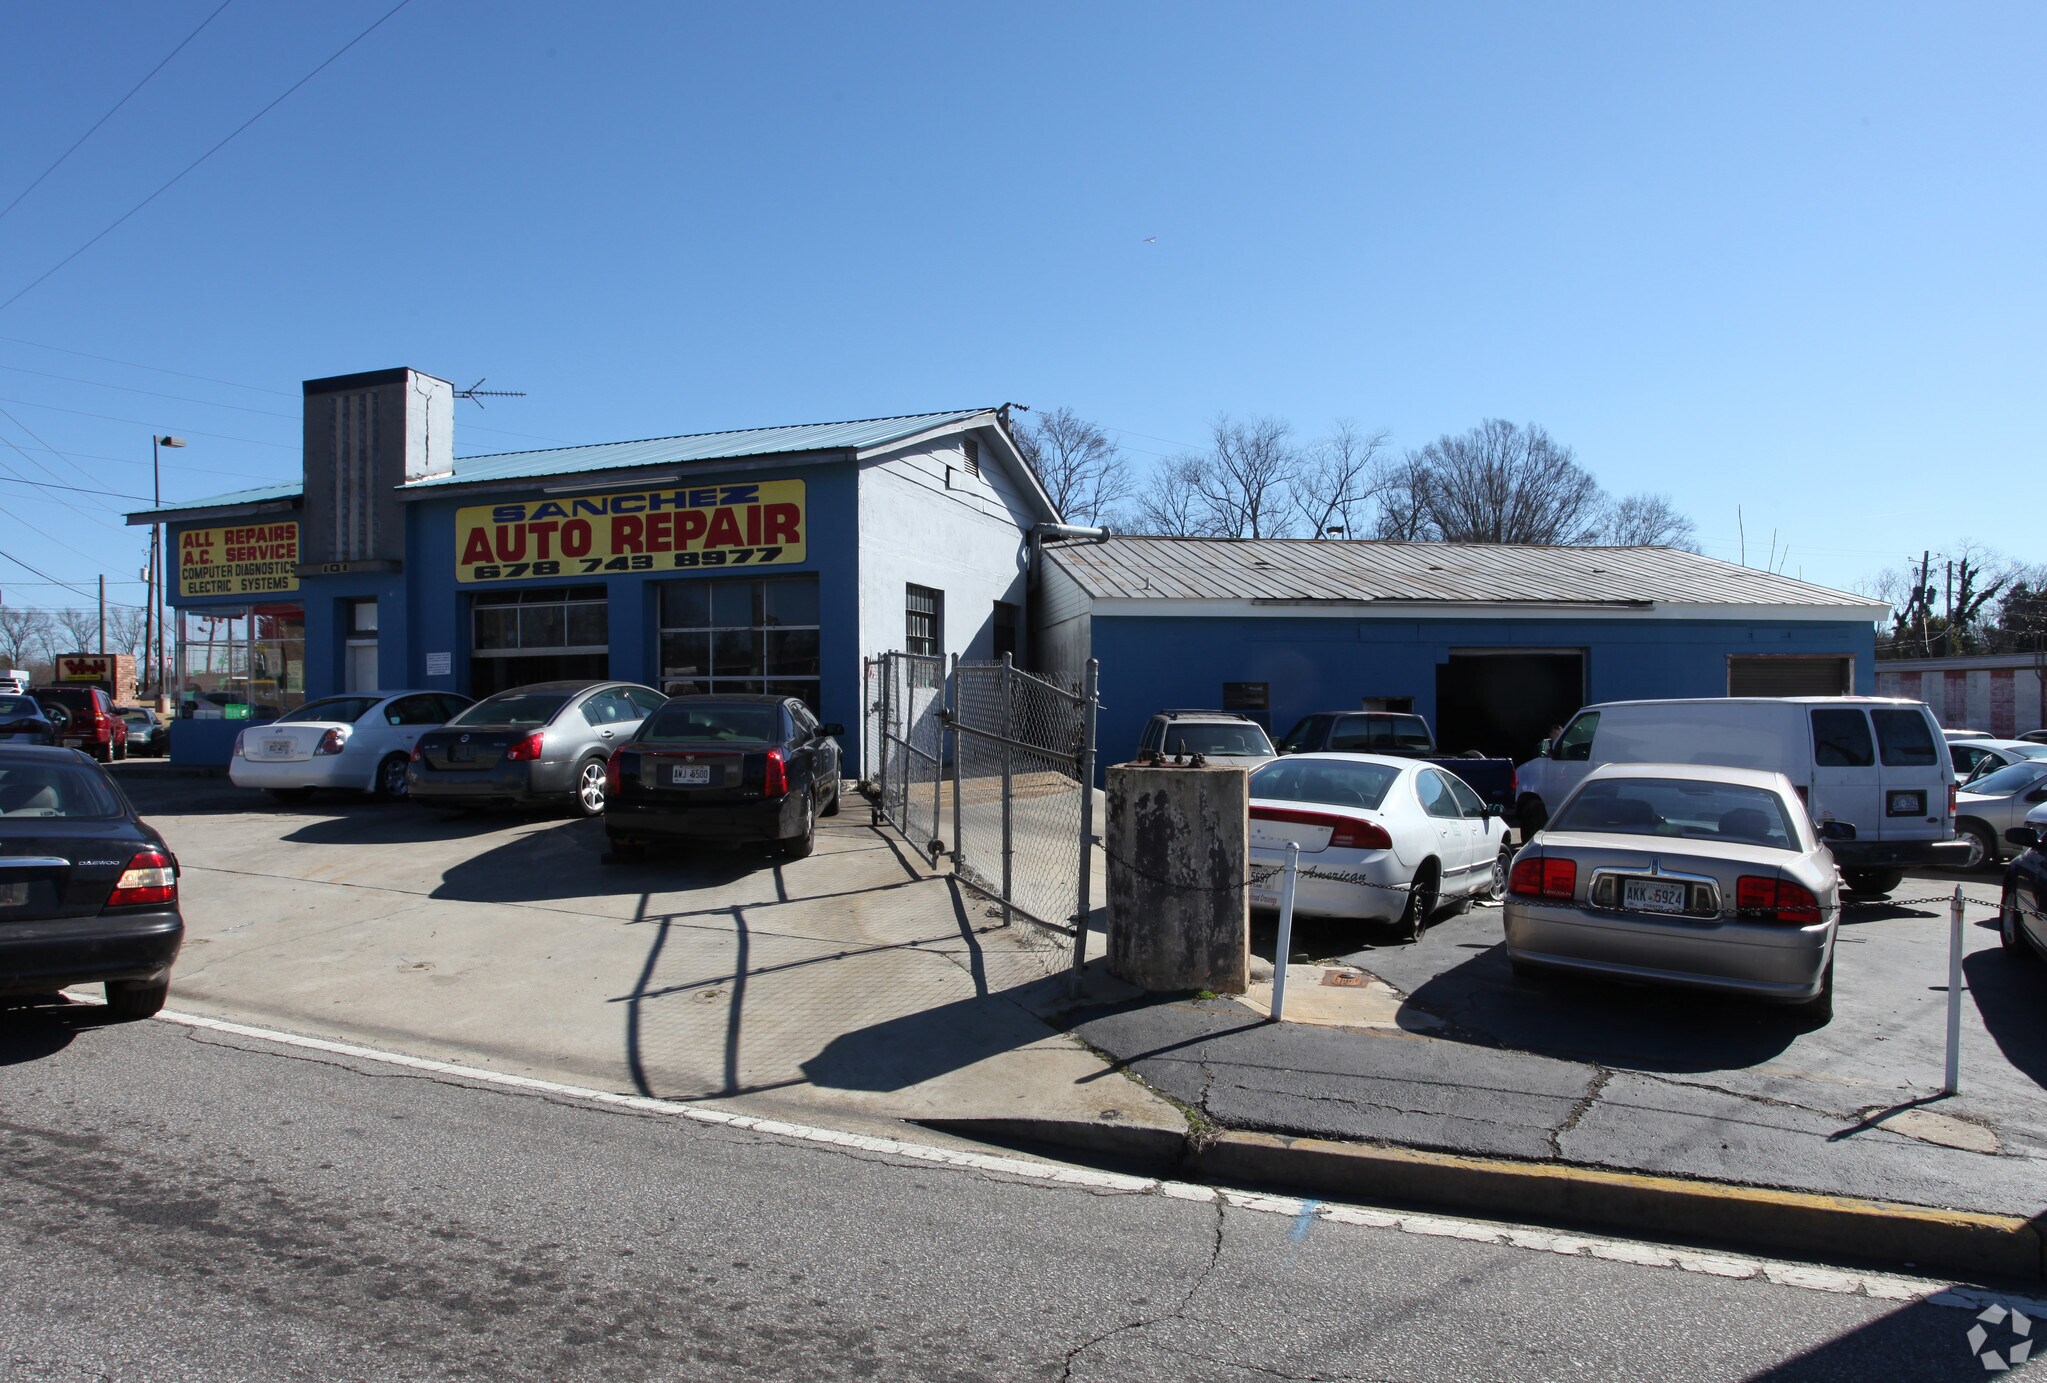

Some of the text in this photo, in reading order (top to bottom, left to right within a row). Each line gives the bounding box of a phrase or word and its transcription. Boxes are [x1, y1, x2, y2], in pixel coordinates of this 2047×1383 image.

[493, 485, 760, 524] SANCHEZ
[182, 524, 297, 549] ALL REPAIRS
[461, 502, 801, 566] AUTO REPAIR
[182, 543, 297, 566] A.C. SERVICE
[473, 546, 784, 580] 678 743 8977
[182, 560, 297, 580] COMPUTER DIAGNOSTICS
[188, 576, 289, 594] ELECTRIC SYSTEMS
[1301, 864, 1368, 882] American
[1543, 889, 1571, 897] LINCOLN
[1626, 885, 1646, 901] AKK
[1655, 889, 1682, 906] 5924
